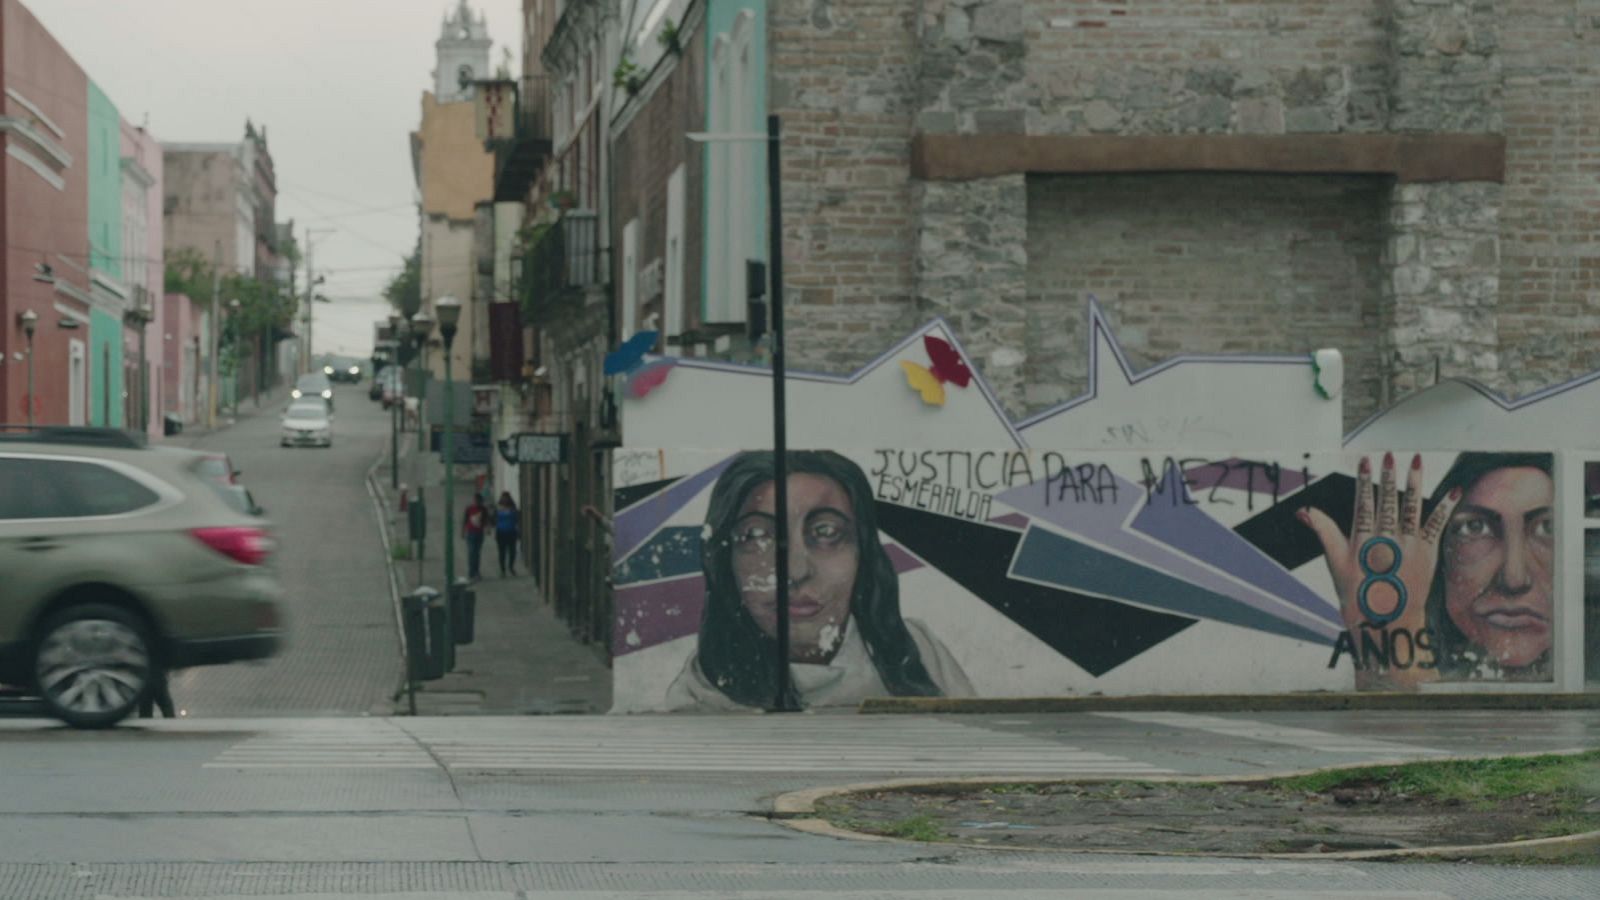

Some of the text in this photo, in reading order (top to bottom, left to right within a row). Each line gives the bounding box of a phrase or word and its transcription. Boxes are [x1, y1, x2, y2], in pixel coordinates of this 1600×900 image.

[870, 449, 1034, 490] JUSTICIA
[1043, 452, 1118, 507] PARA
[1358, 536, 1408, 626] 8
